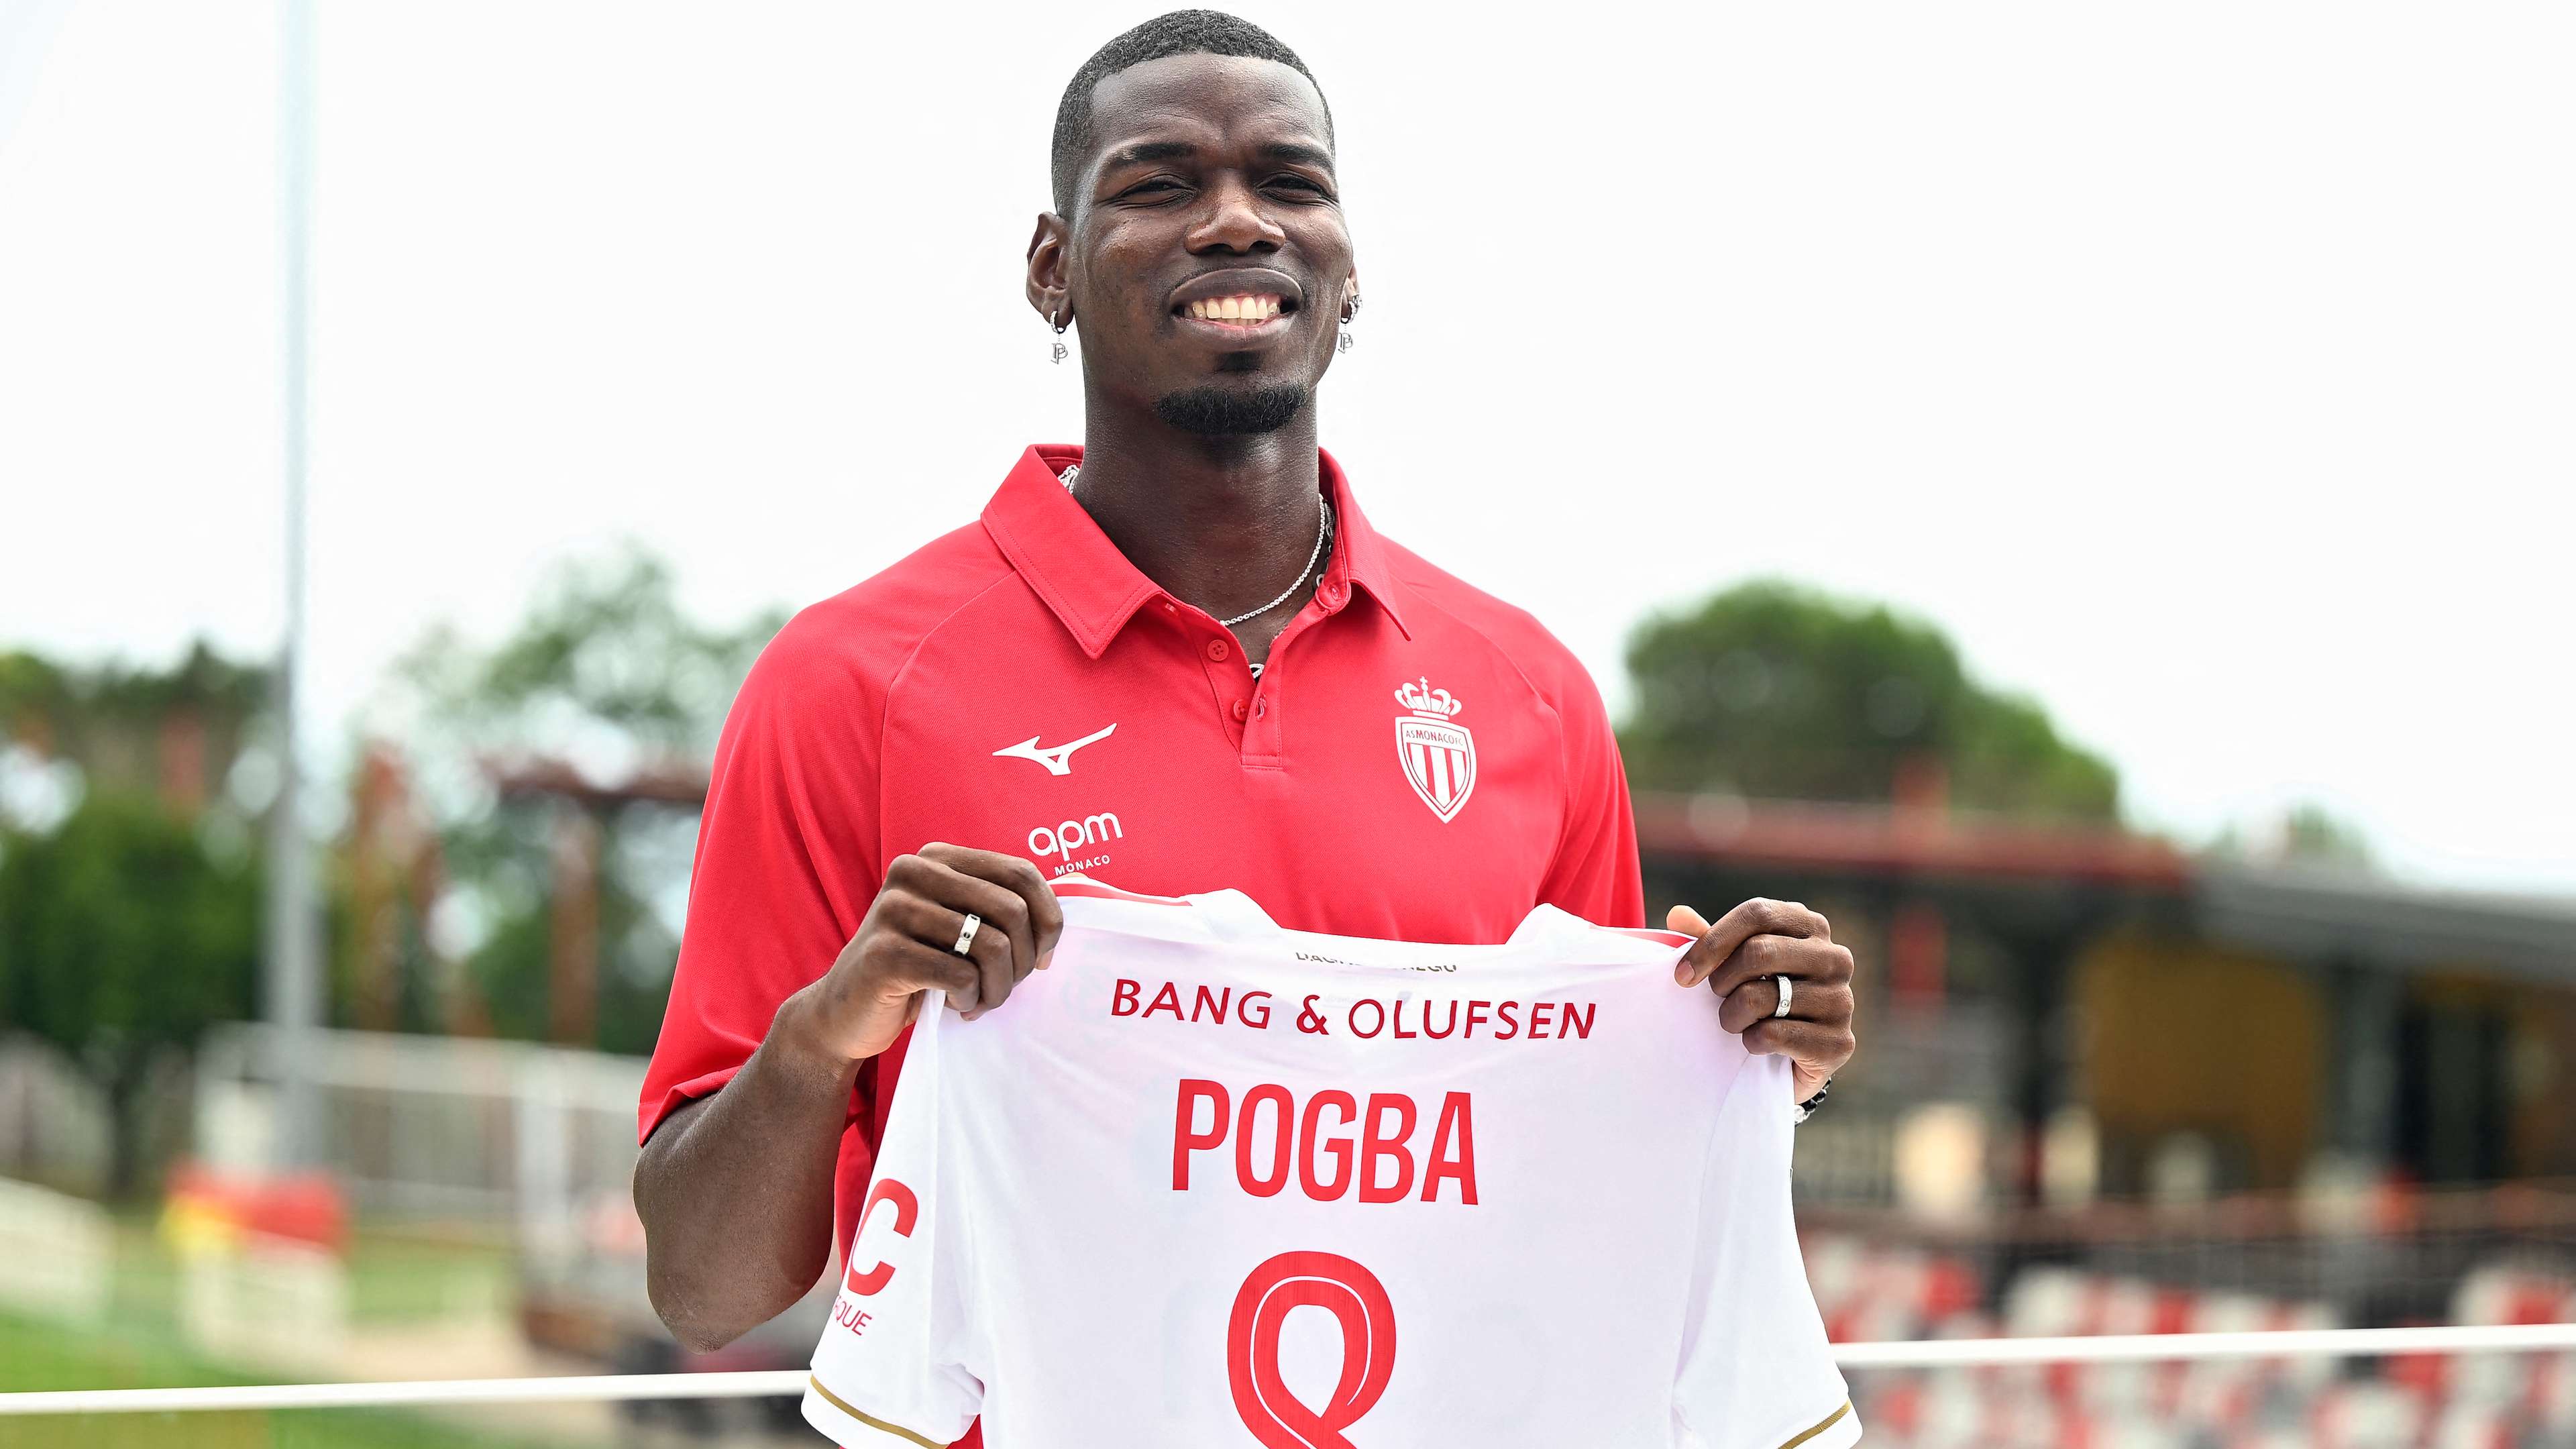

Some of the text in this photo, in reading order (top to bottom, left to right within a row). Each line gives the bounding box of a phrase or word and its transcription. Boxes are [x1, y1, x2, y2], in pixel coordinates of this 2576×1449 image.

[1028, 812, 1124, 861] apm
[1054, 855, 1111, 875] MONACO
[1111, 978, 1597, 1040] BANG & OLUFSEN
[1172, 1078, 1479, 1206] POGBA
